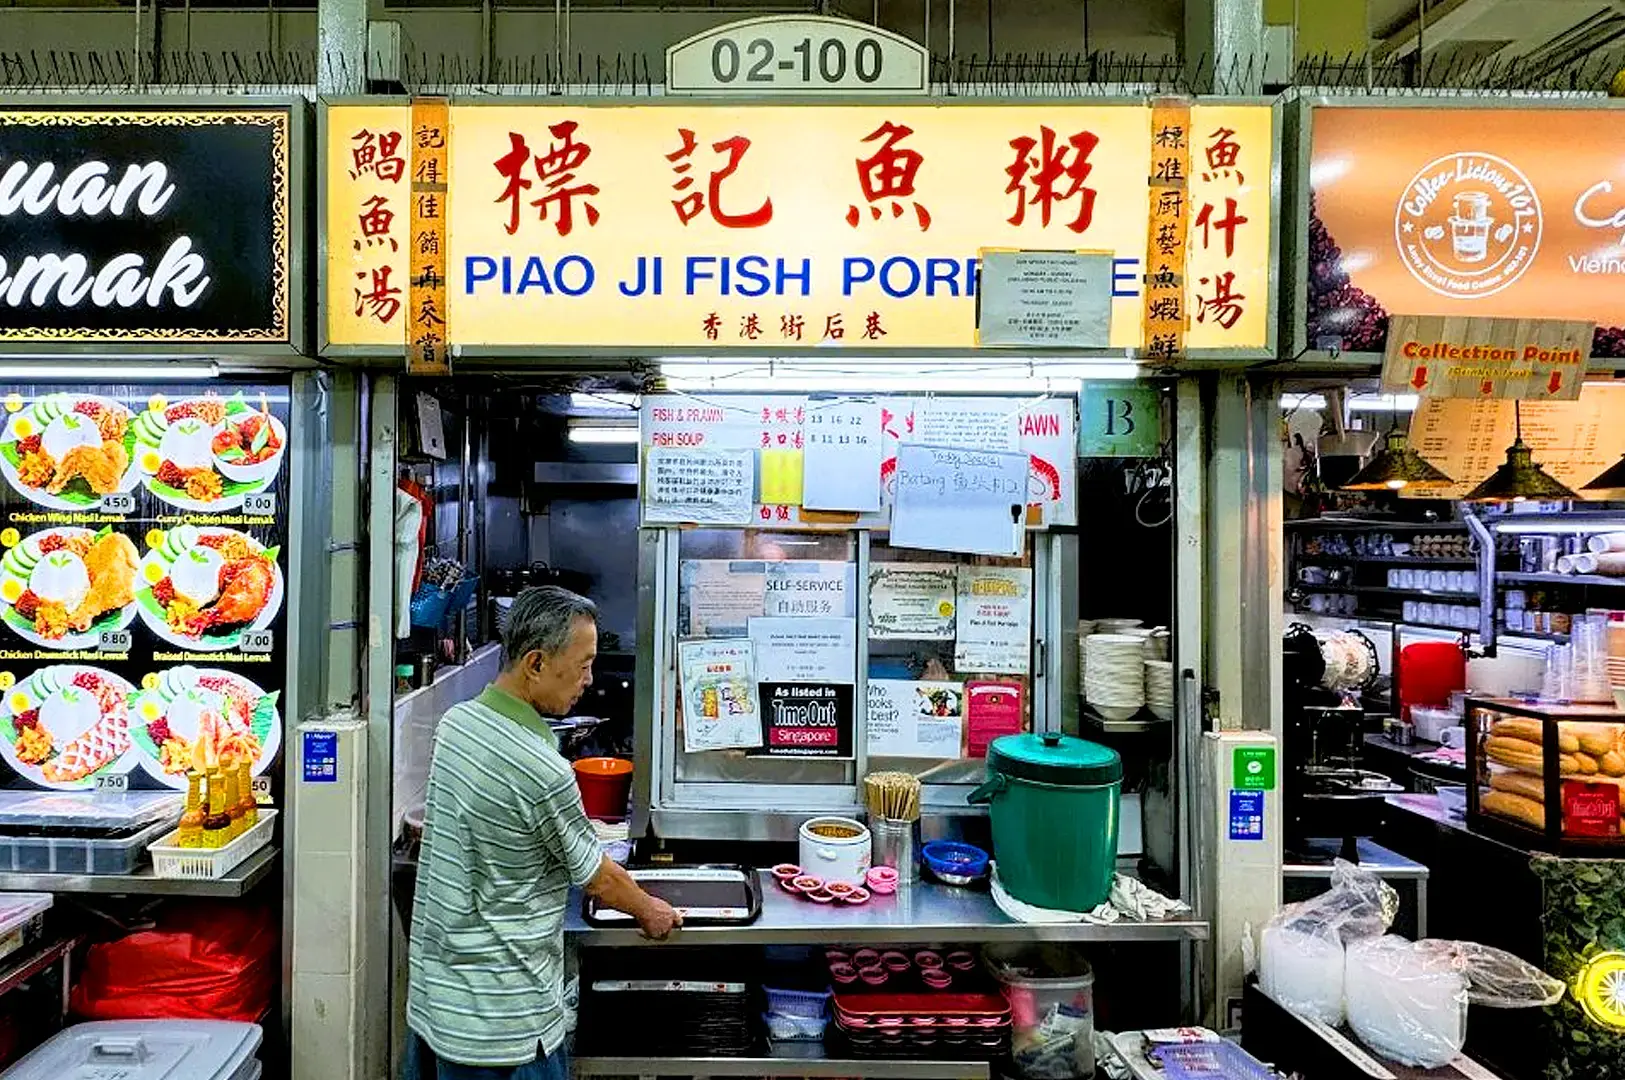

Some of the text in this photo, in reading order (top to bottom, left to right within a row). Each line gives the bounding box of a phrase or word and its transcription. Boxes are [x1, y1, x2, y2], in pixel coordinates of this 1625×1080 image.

[712, 38, 883, 83] 02-100
[493, 120, 1099, 236] 標記魚粥
[1195, 127, 1248, 329] 魚什湯
[0, 236, 210, 307] mak
[466, 255, 595, 297] PIAO
[619, 256, 662, 297] JI
[686, 255, 811, 298] FISH
[1403, 342, 1581, 363] Collection Point
[652, 409, 674, 422] FISH
[686, 409, 724, 422] PRAWN
[1103, 398, 1135, 436] B
[1019, 414, 1060, 436] AWN
[652, 432, 704, 446] FISH SOUP
[766, 580, 843, 591] SELF-SERVICE
[779, 599, 832, 614] 自助服务
[244, 634, 270, 646] 7.00
[775, 687, 836, 697] As listed in
[778, 729, 832, 744] Singapore
[97, 777, 124, 788] 7.50
